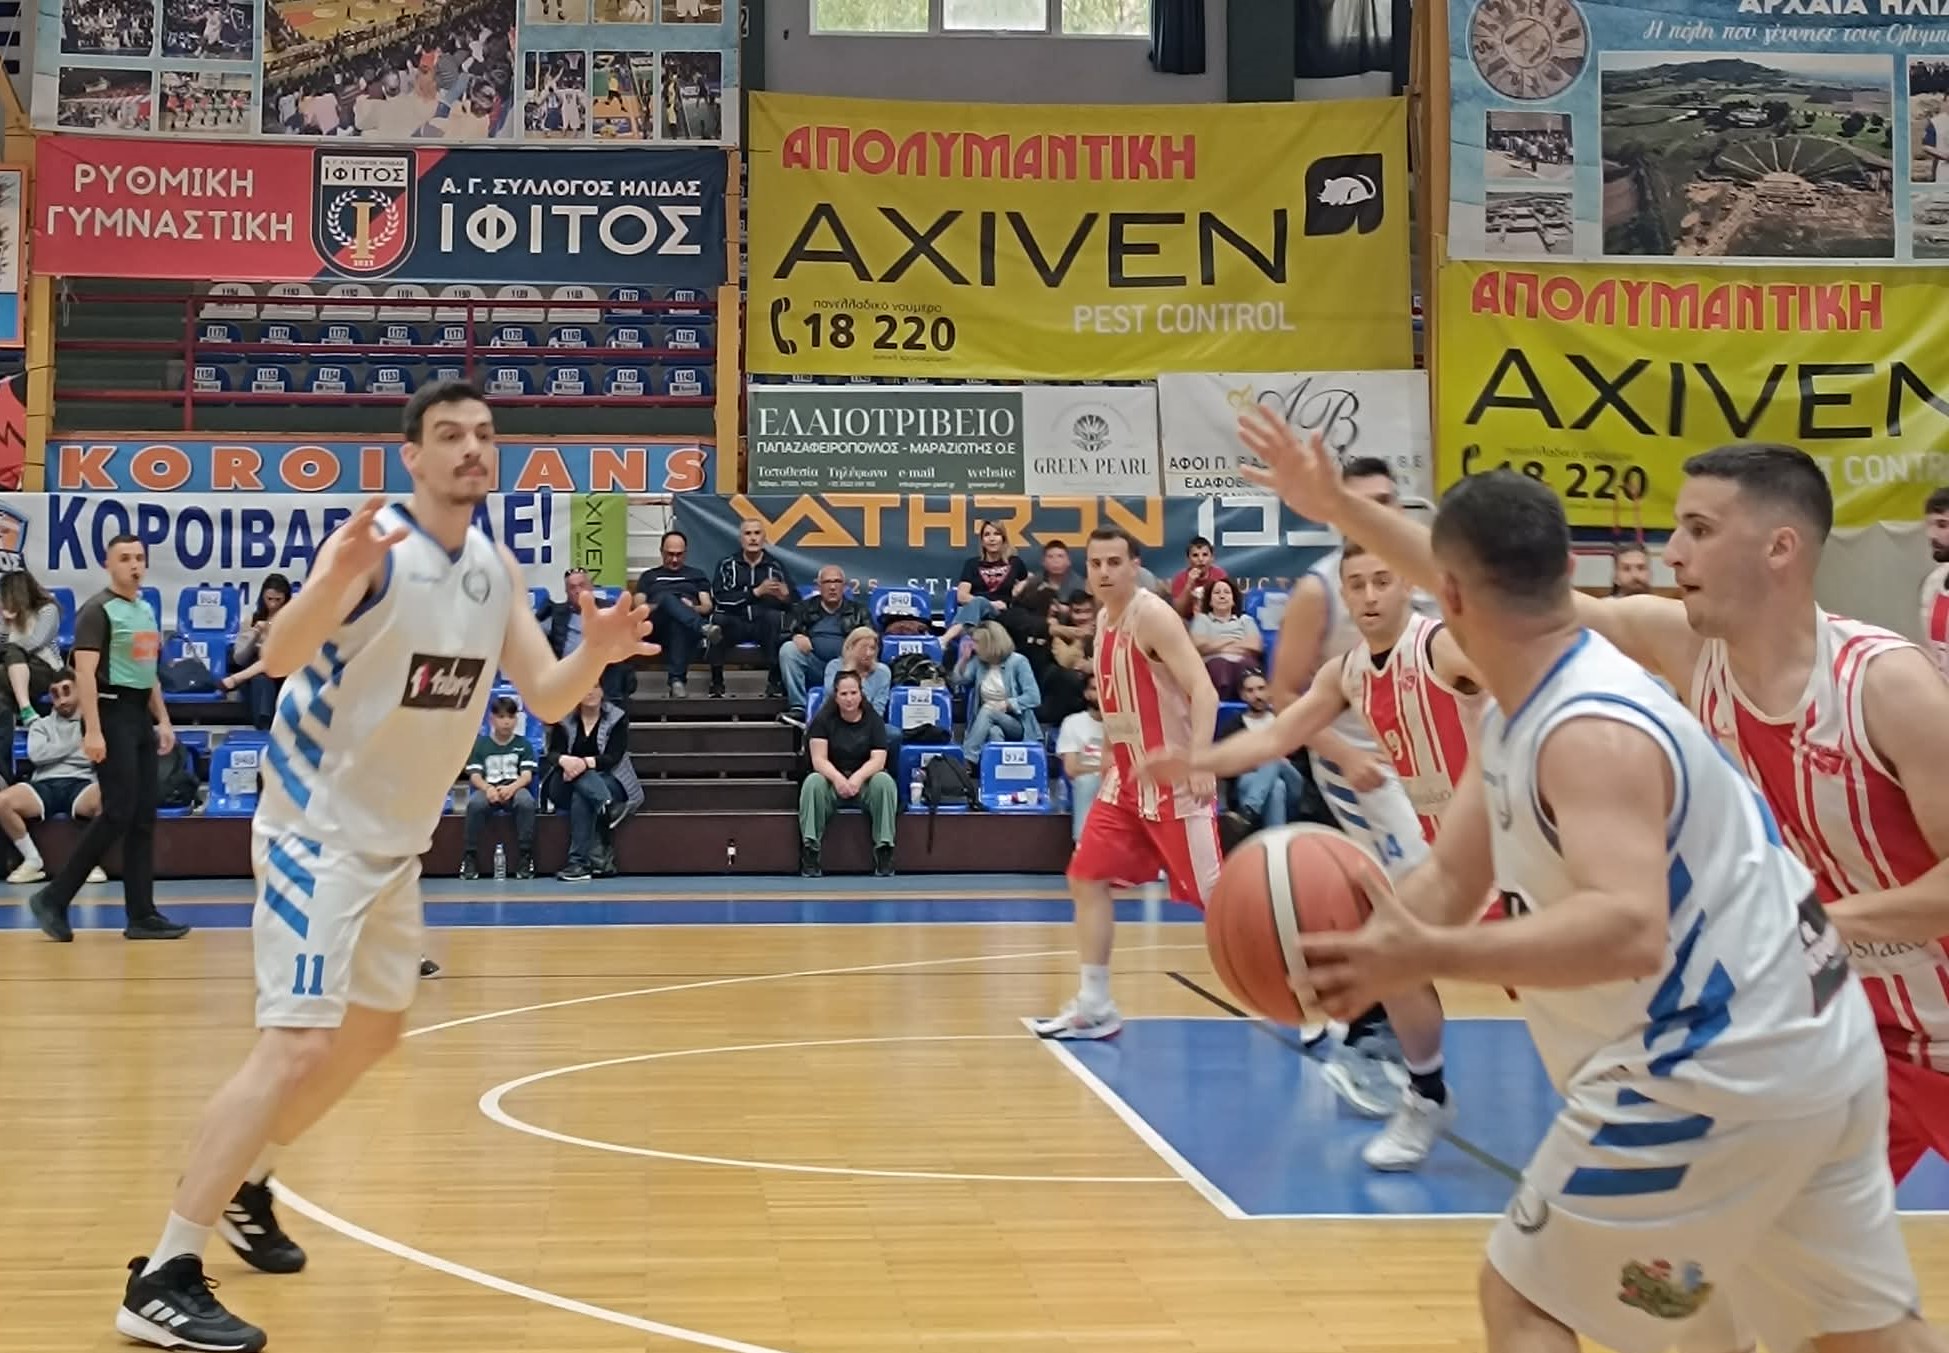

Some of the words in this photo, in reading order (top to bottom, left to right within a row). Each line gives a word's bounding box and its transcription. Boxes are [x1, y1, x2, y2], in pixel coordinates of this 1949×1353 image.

[1721, 25, 1757, 40] που
[1843, 26, 1881, 44] τους
[781, 126, 1196, 181] ΑΠΟΛΥΜΑΝΤΙΚΗ
[74, 164, 255, 198] ΡΥΘΜΙΚΗ
[325, 167, 404, 182] ΙΦΙΤΟΣ
[440, 177, 461, 194] Α.
[468, 178, 487, 195] Γ.
[493, 179, 613, 196] ΣΥΛΛΟΓΟΣ
[620, 180, 701, 197] ΗΛΙΔΑΣ
[47, 207, 293, 243] ΓΥΜΝΑΣΤΙΚΗ
[441, 202, 702, 255] ΙΦΙΤΟΣ
[774, 202, 1287, 288] AXIVEN
[1074, 303, 1146, 333] PEST
[1157, 301, 1295, 333] CONTROL
[1471, 270, 1884, 331] ΑΠΟΛΥΜΑΝΤΙΚΗ
[803, 313, 855, 348] 18
[873, 314, 956, 351] 220
[758, 407, 1015, 437] ΕΛΑΙΟΤΡΙΒΕΙΟ
[757, 441, 899, 454] ΠΑΠΑΖΑΦΕΙΡΟΠΟΥΛΟΣ
[909, 442, 993, 455] ΜΑΡΑΖΙΩΤΗΣ
[1169, 456, 1209, 470] ΑΦΟΙ
[58, 445, 708, 492] KOROIANS
[757, 466, 818, 478] Τοποθεσία
[828, 465, 887, 480] Τηλέφωνο
[967, 466, 1016, 478] website
[1034, 457, 1089, 475] GREEN
[1095, 457, 1151, 475] PEARL
[1565, 463, 1648, 501] 220
[1384, 729, 1402, 760] 9
[292, 953, 324, 996] 11
